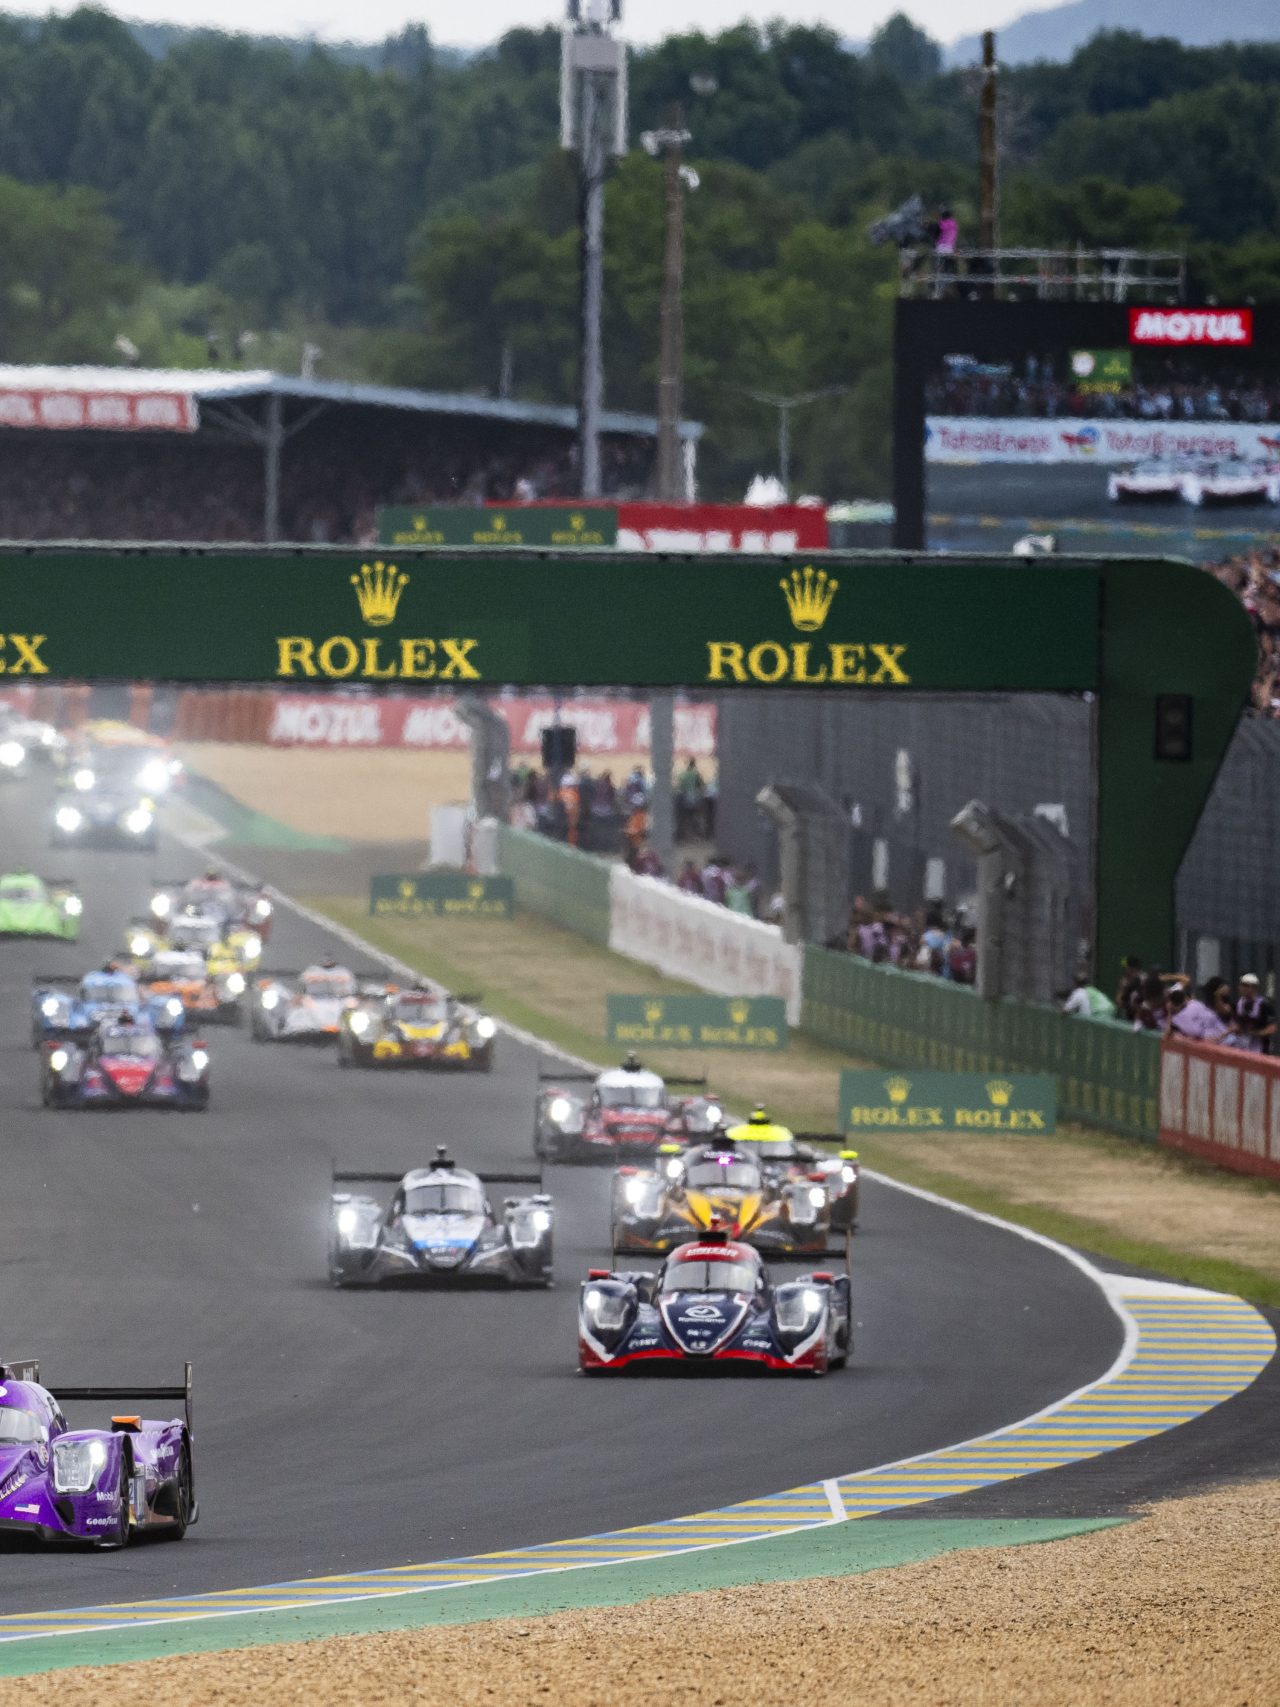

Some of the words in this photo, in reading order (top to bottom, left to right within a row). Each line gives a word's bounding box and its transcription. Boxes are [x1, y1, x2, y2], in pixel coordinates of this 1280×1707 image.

[1135, 312, 1246, 341] MOTUL
[277, 635, 481, 679] ROLEX
[707, 641, 910, 684] ROLEX
[271, 702, 381, 744] MOTUL
[850, 1106, 944, 1126] ROLEX
[954, 1108, 1046, 1129] ROLEX
[86, 1515, 118, 1527] GOODYEAR
